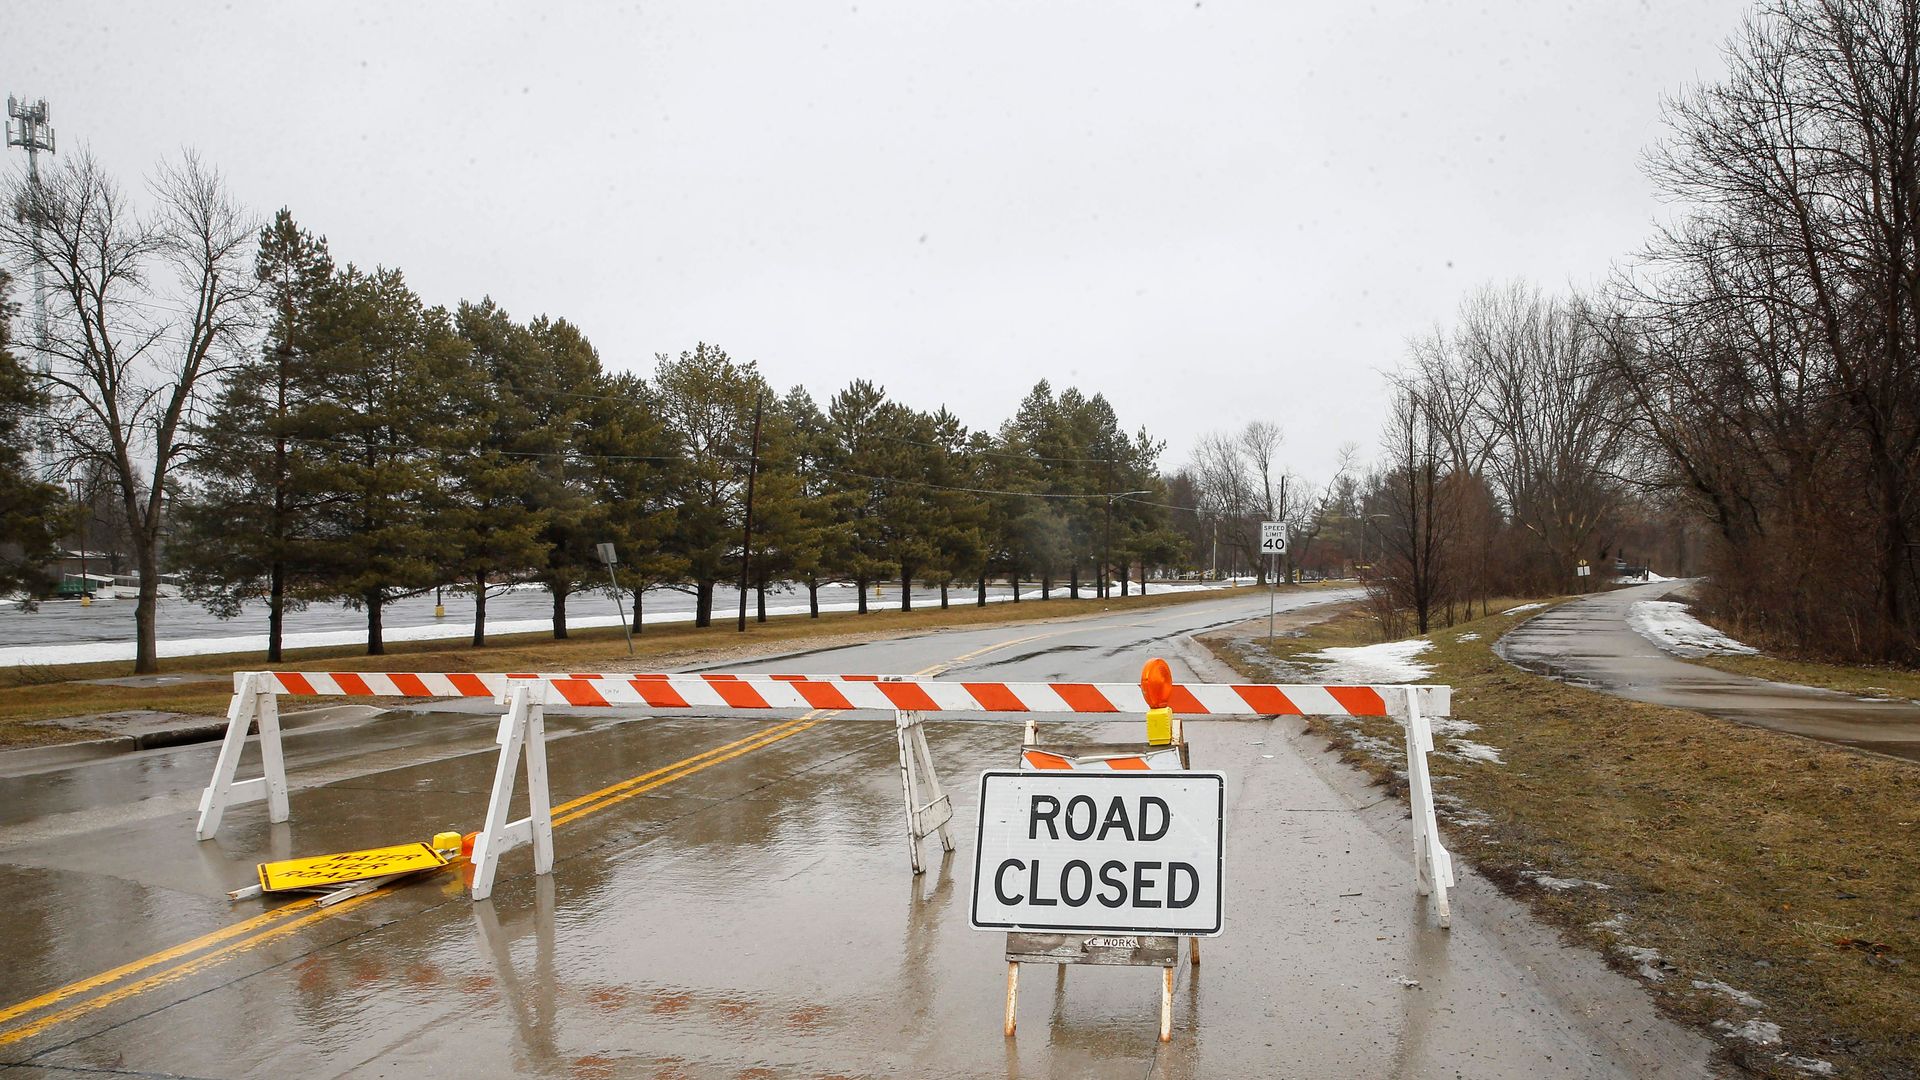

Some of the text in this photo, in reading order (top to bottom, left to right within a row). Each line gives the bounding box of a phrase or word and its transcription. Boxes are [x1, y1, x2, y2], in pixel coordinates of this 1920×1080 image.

[1263, 538, 1285, 550] 40
[1029, 795, 1171, 841] ROAD
[330, 853, 422, 862] WATER
[308, 862, 390, 870] OVER
[275, 870, 363, 879] ROAD
[994, 858, 1200, 908] CLOSED
